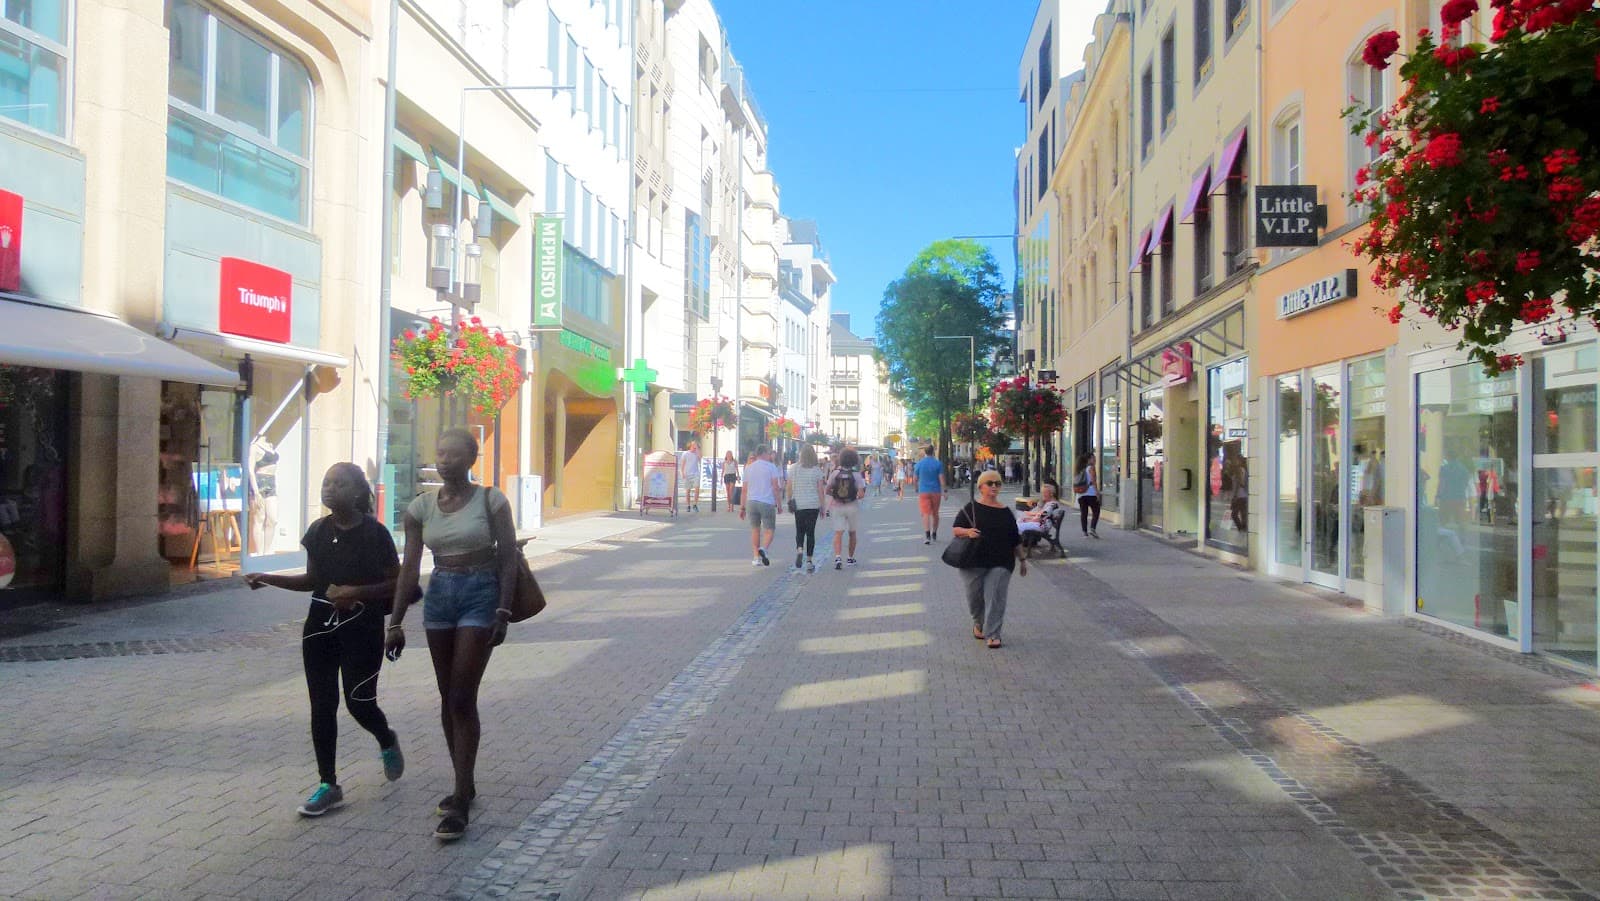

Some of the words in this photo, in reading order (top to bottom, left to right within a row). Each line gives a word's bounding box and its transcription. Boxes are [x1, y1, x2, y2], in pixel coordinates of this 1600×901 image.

[1260, 197, 1313, 213] Little
[1261, 218, 1313, 234] V.I.P.
[540, 222, 556, 298] MEPHISTO
[237, 287, 281, 313] Triumph
